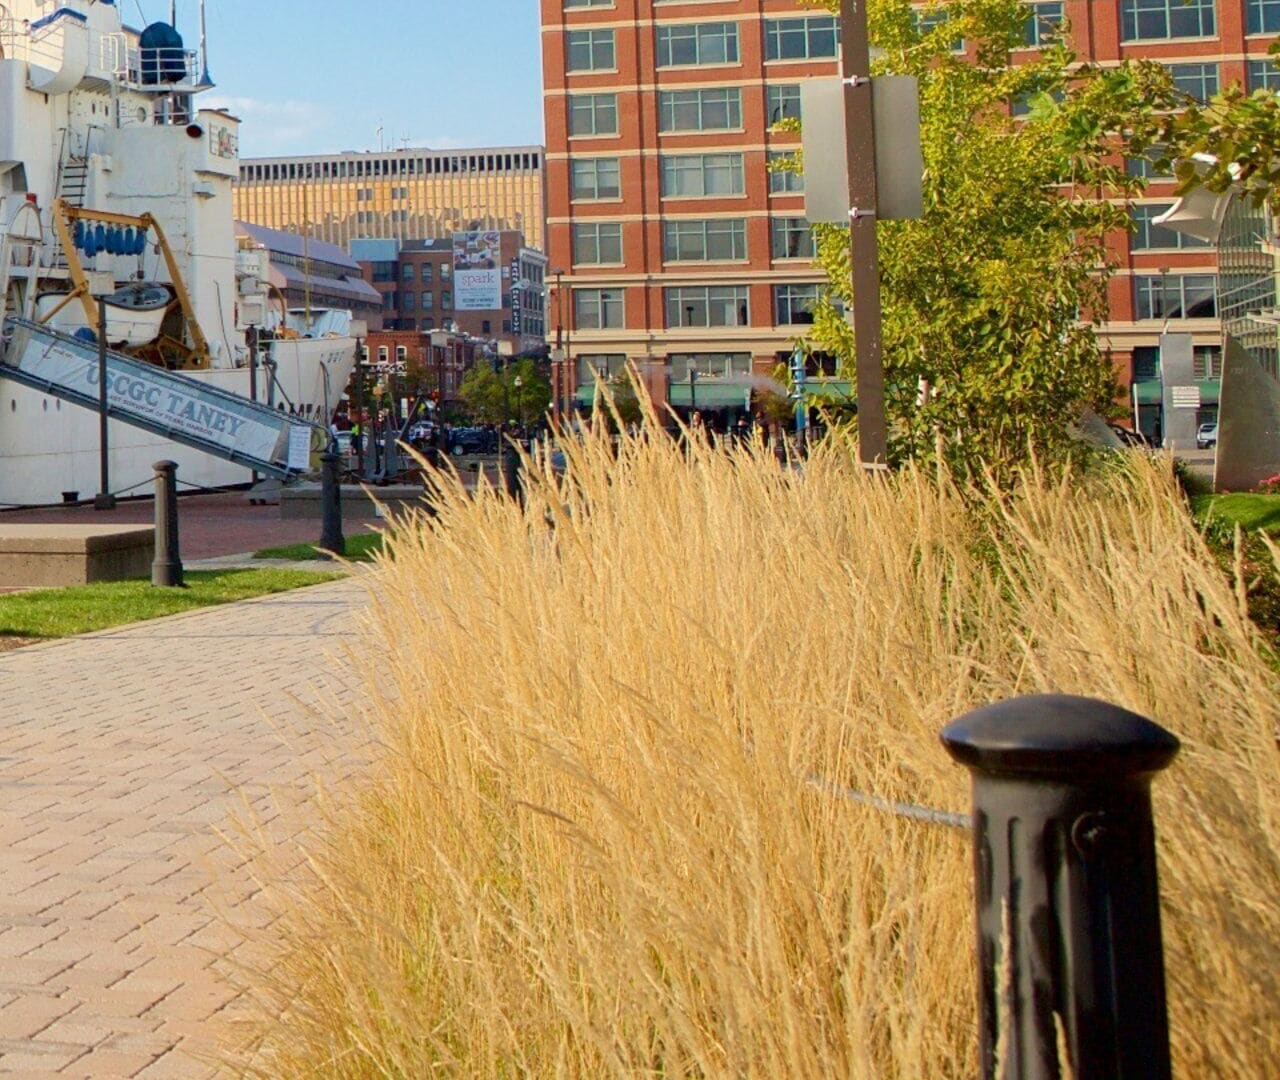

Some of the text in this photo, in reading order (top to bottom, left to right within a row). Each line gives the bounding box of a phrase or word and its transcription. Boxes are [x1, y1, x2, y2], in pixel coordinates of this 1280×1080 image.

[463, 271, 495, 287] spark
[86, 363, 245, 437] USCGC TANEY
